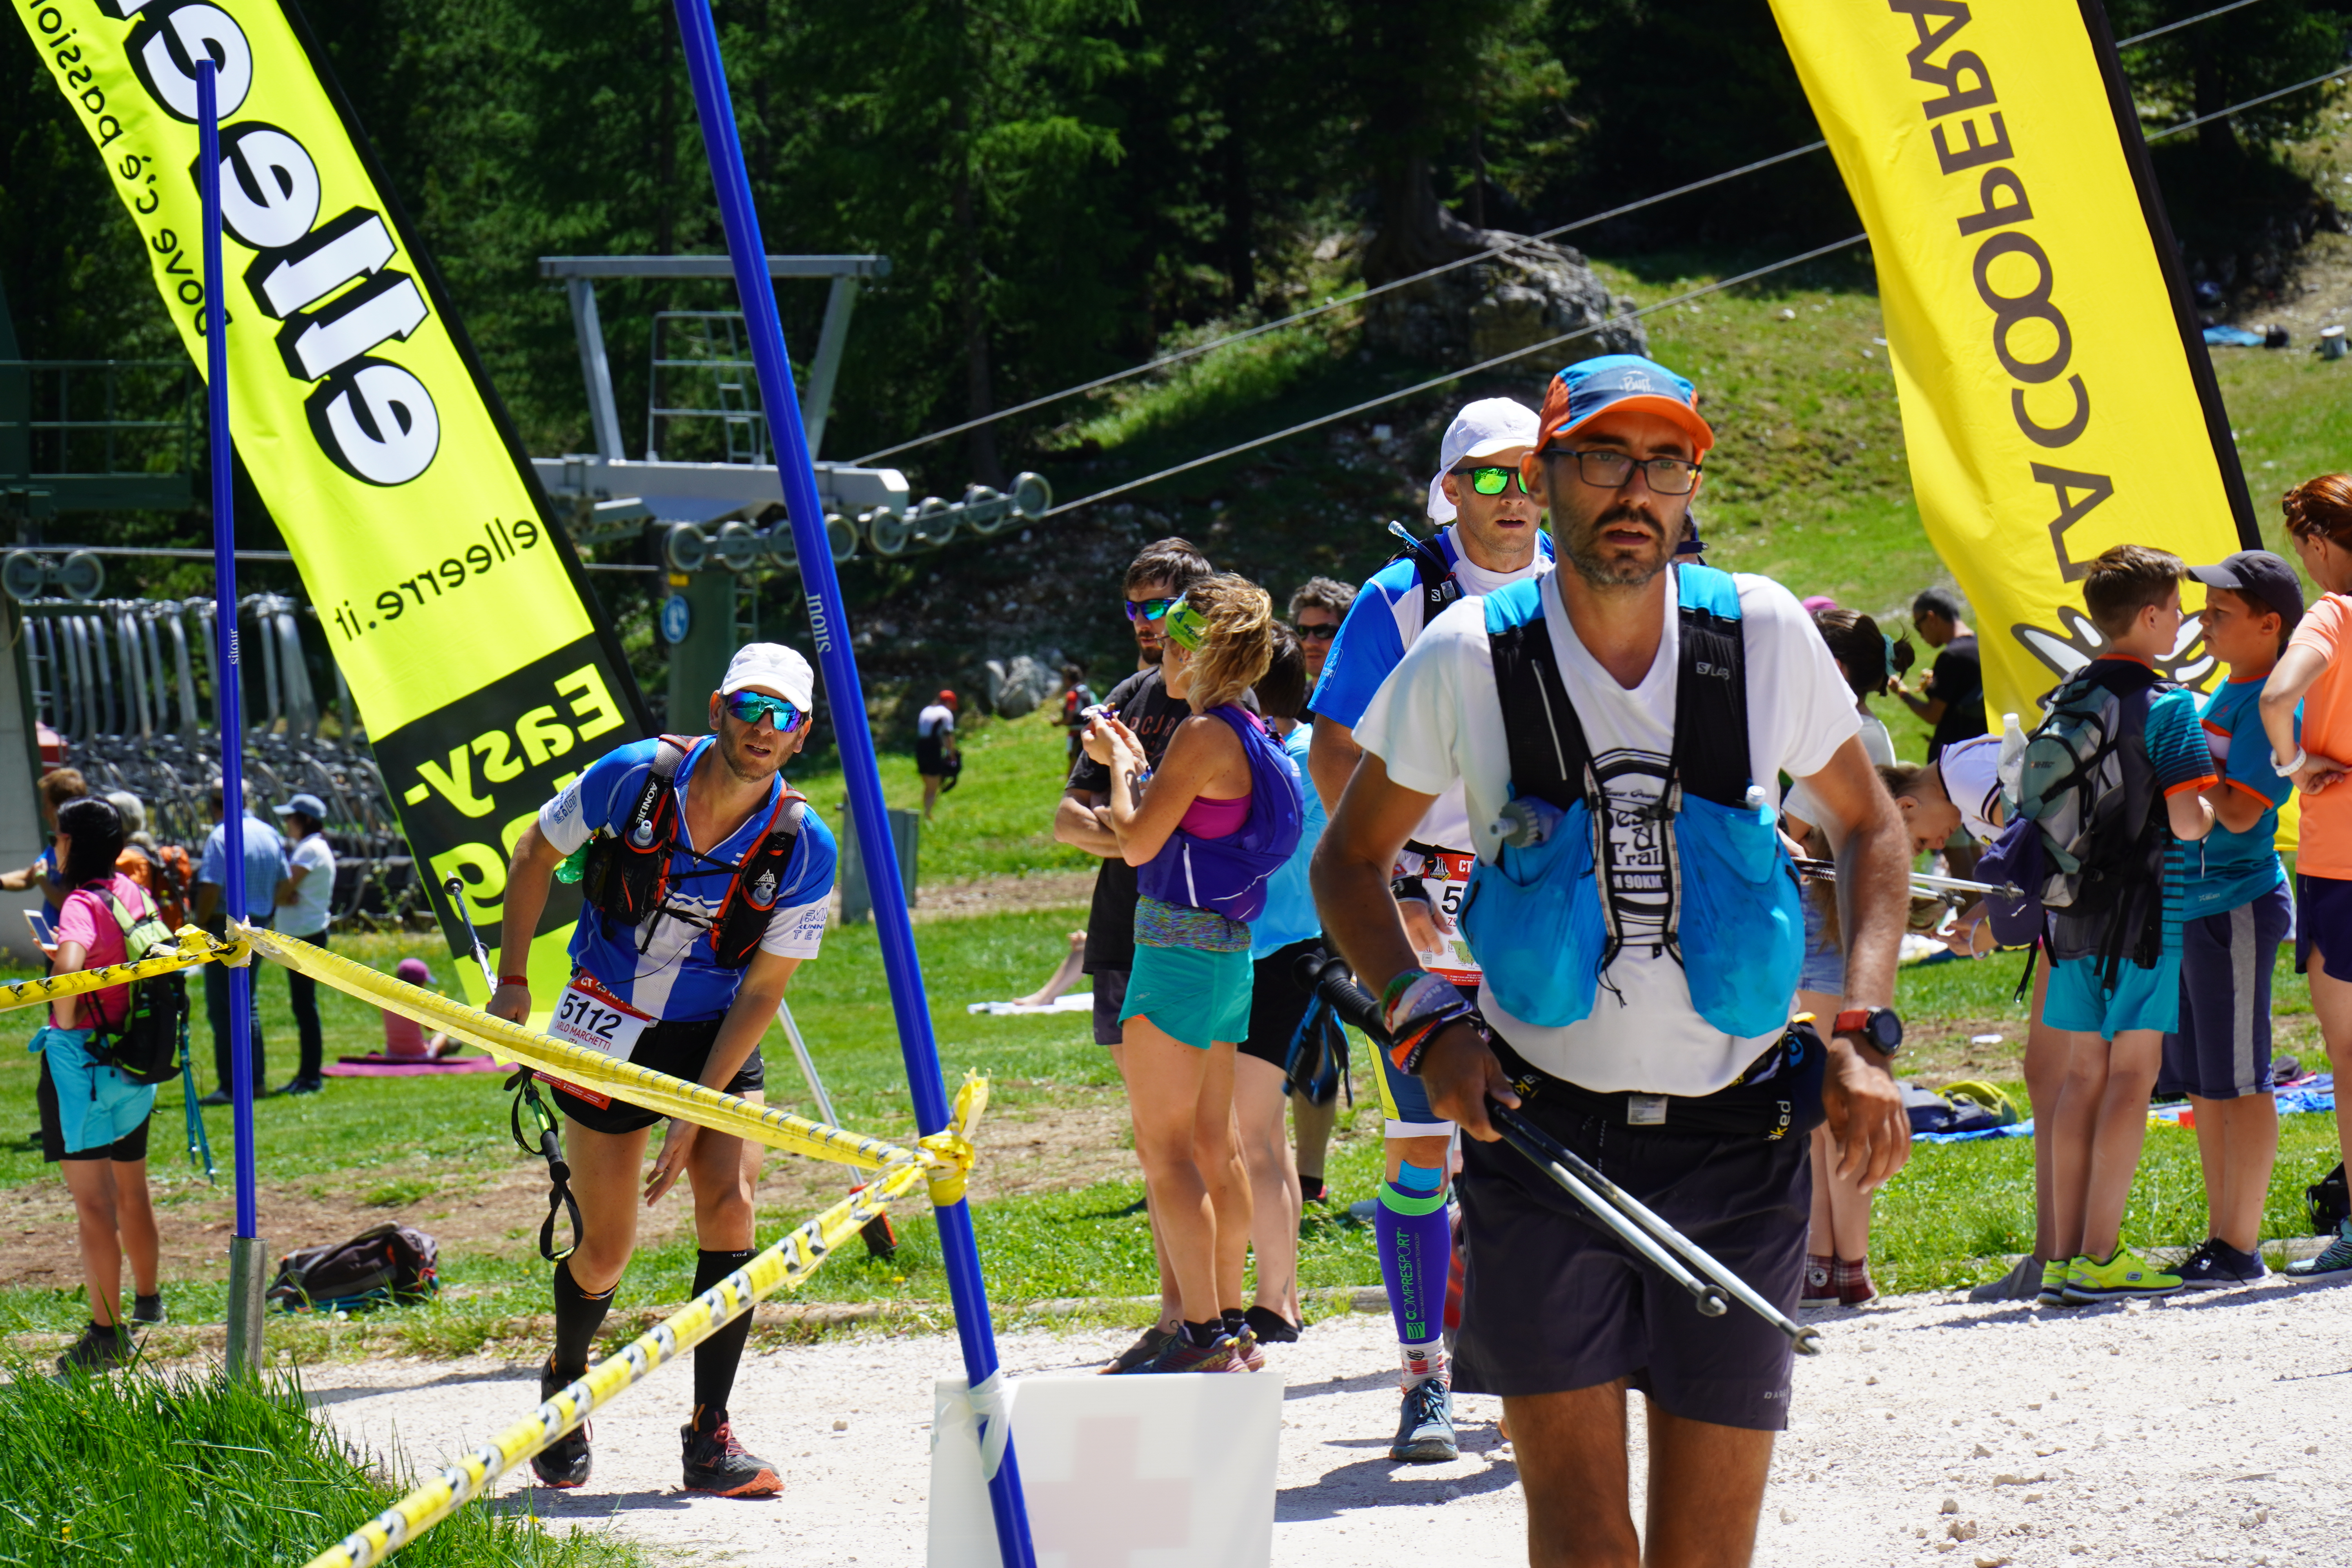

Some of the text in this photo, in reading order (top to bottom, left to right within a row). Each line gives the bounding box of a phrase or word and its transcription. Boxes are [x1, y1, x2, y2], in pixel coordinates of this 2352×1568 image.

[635, 782, 658, 824] AONIJIE
[1624, 875, 1663, 889] 90KM
[1441, 886, 1466, 915] 5
[560, 993, 622, 1040] 5112
[555, 1020, 570, 1032] CARLO
[570, 1025, 612, 1051] MARCHETTI
